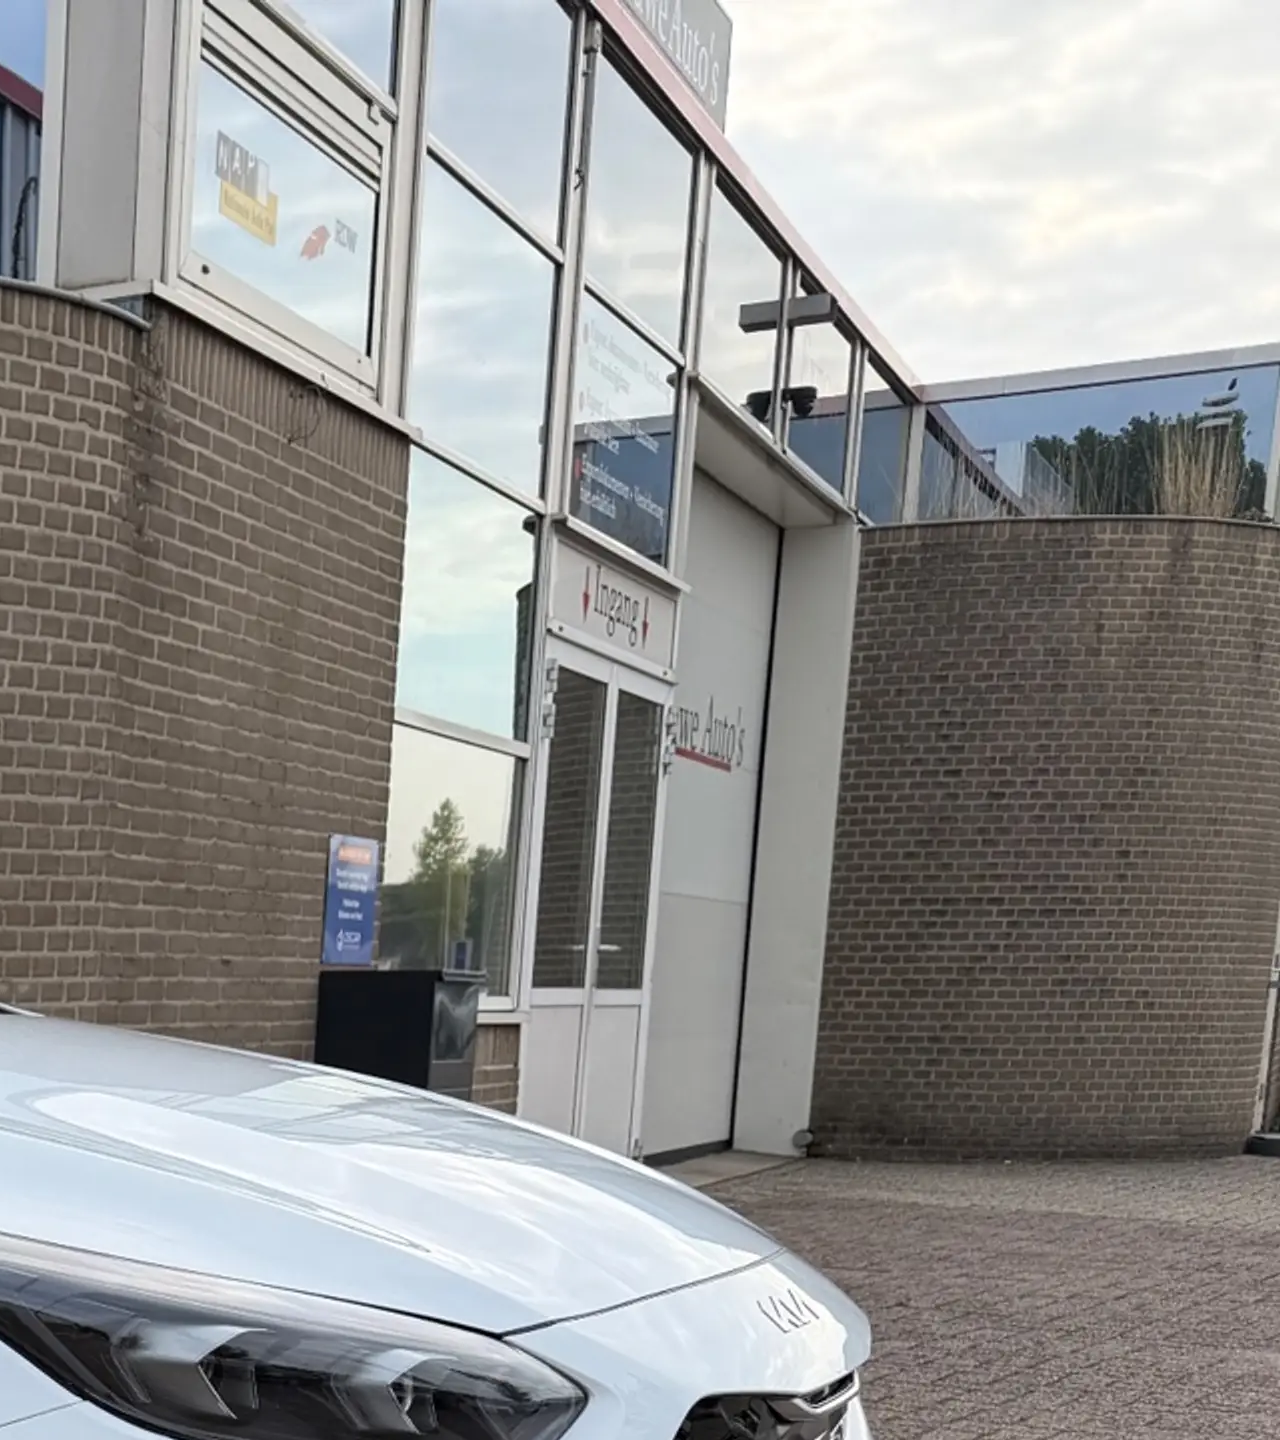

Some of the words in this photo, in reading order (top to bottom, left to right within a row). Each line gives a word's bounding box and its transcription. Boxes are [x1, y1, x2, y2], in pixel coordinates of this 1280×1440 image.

[668, 0, 720, 106] Auto's
[594, 564, 640, 648] Ingang
[701, 695, 746, 768] Auto's
